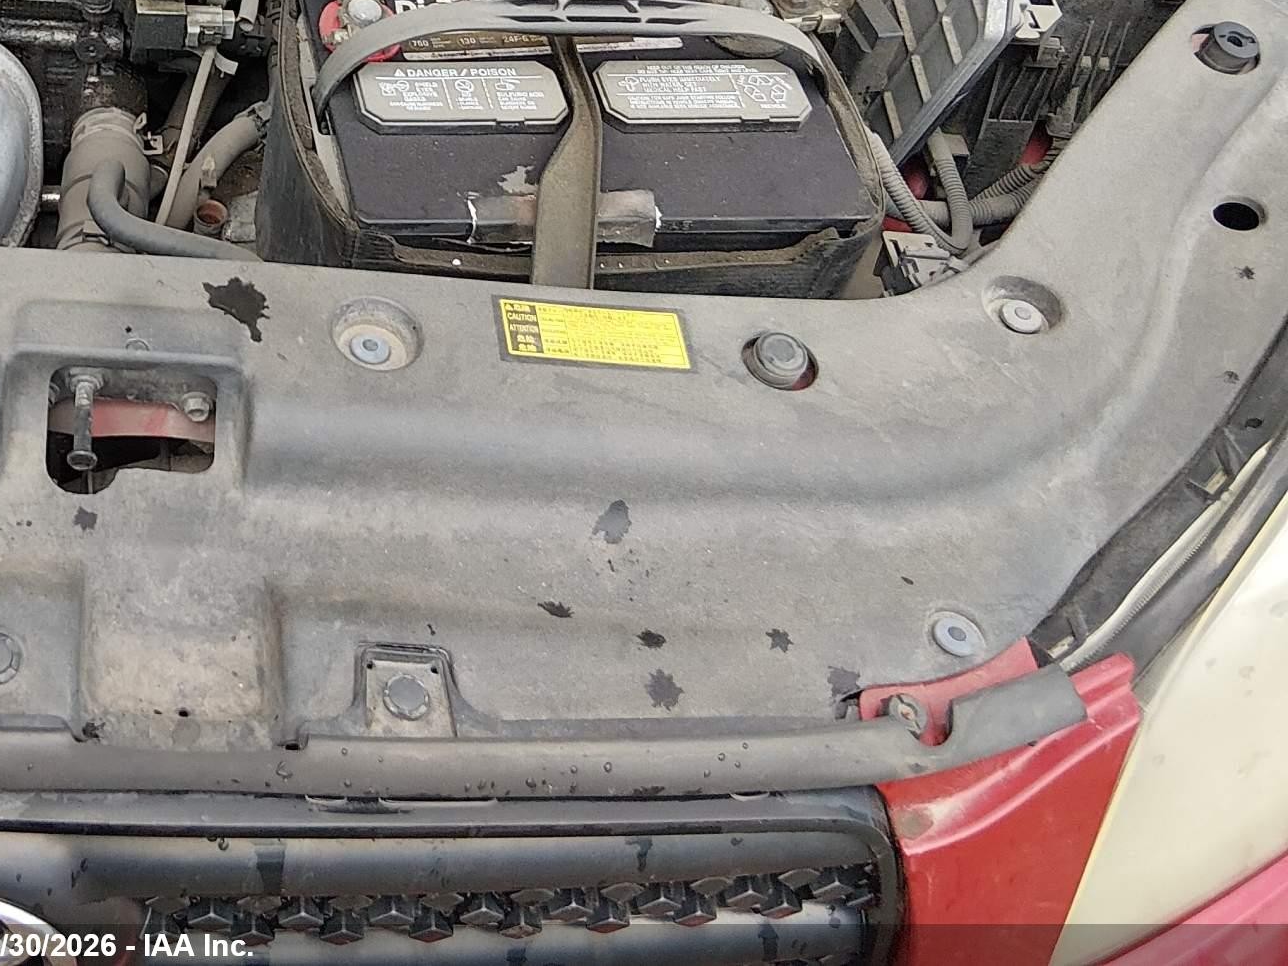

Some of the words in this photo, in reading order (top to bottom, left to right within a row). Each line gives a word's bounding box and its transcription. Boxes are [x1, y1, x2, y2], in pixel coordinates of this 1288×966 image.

[407, 68, 458, 77] DANGER
[470, 68, 517, 76] POISON
[508, 312, 537, 322] CAUTION
